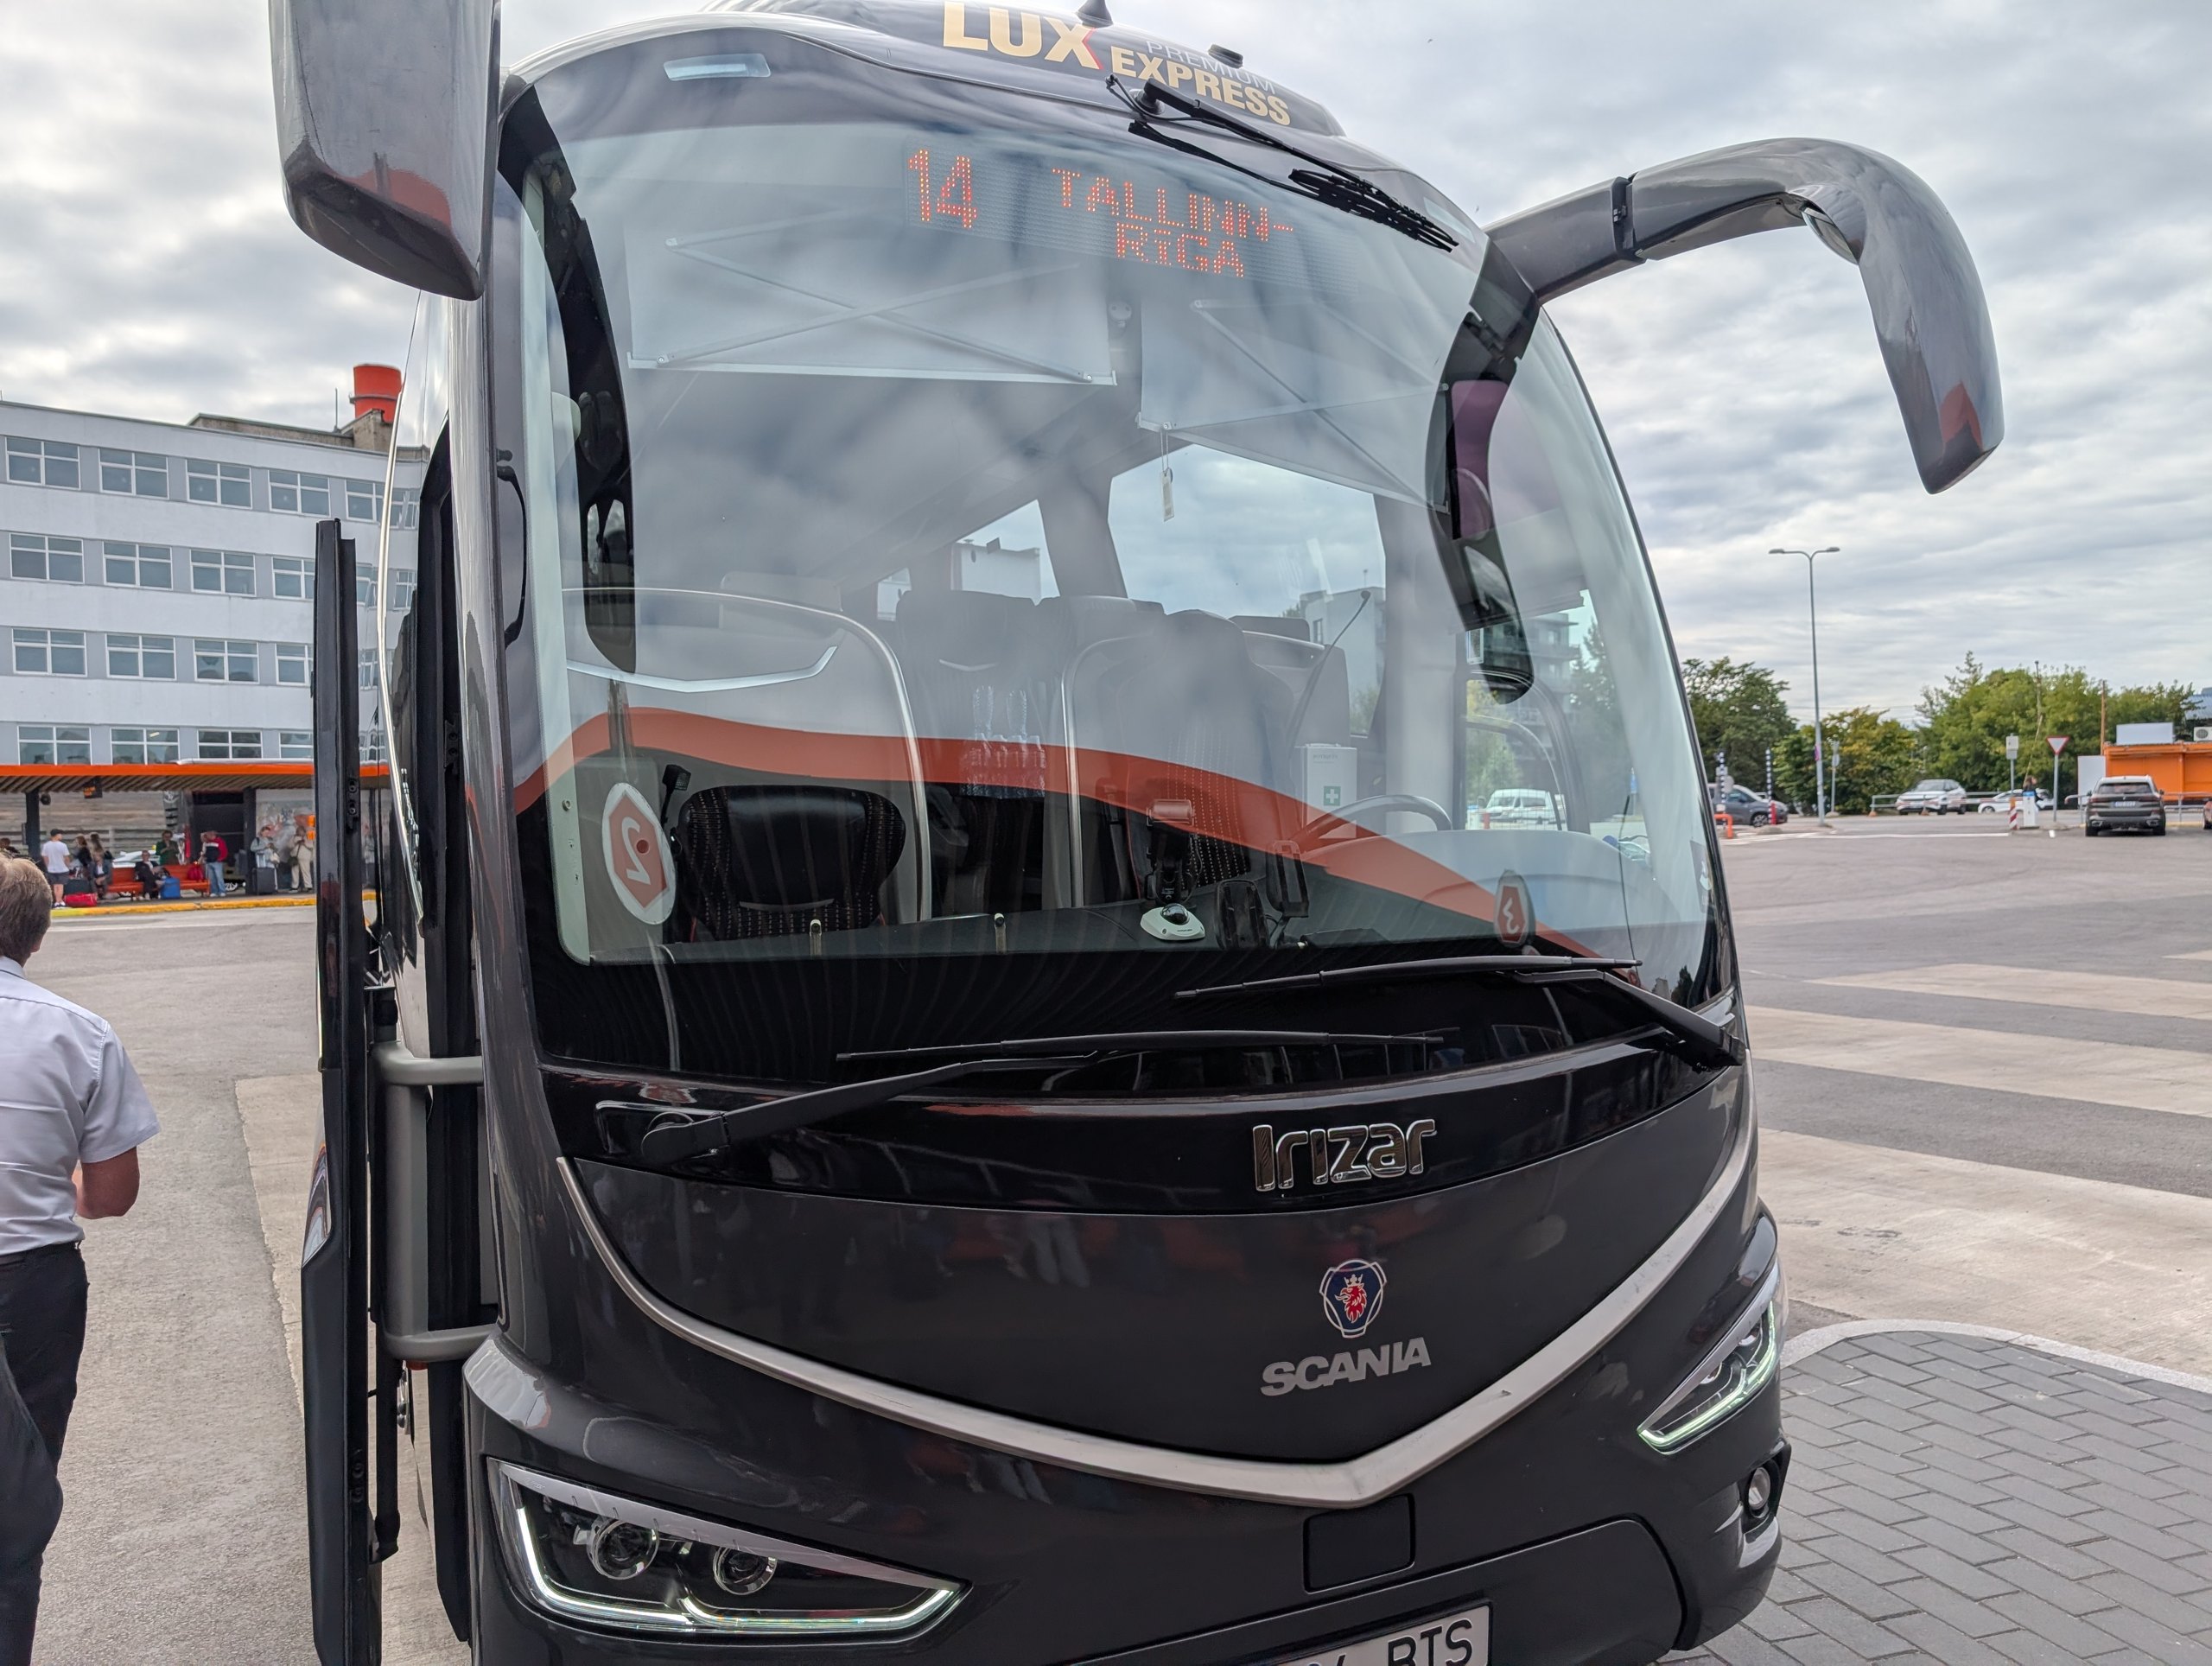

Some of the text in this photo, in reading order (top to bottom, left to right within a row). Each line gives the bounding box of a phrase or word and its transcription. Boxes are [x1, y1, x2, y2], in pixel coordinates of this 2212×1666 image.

[943, 1, 1291, 126] LUX EXPRESS
[1146, 40, 1276, 95] PREMIUM
[908, 149, 977, 228] 14
[1253, 1119, 1437, 1192] Irizar
[1260, 1337, 1432, 1396] SCANIA
[1388, 1618, 1472, 1666] BTS
